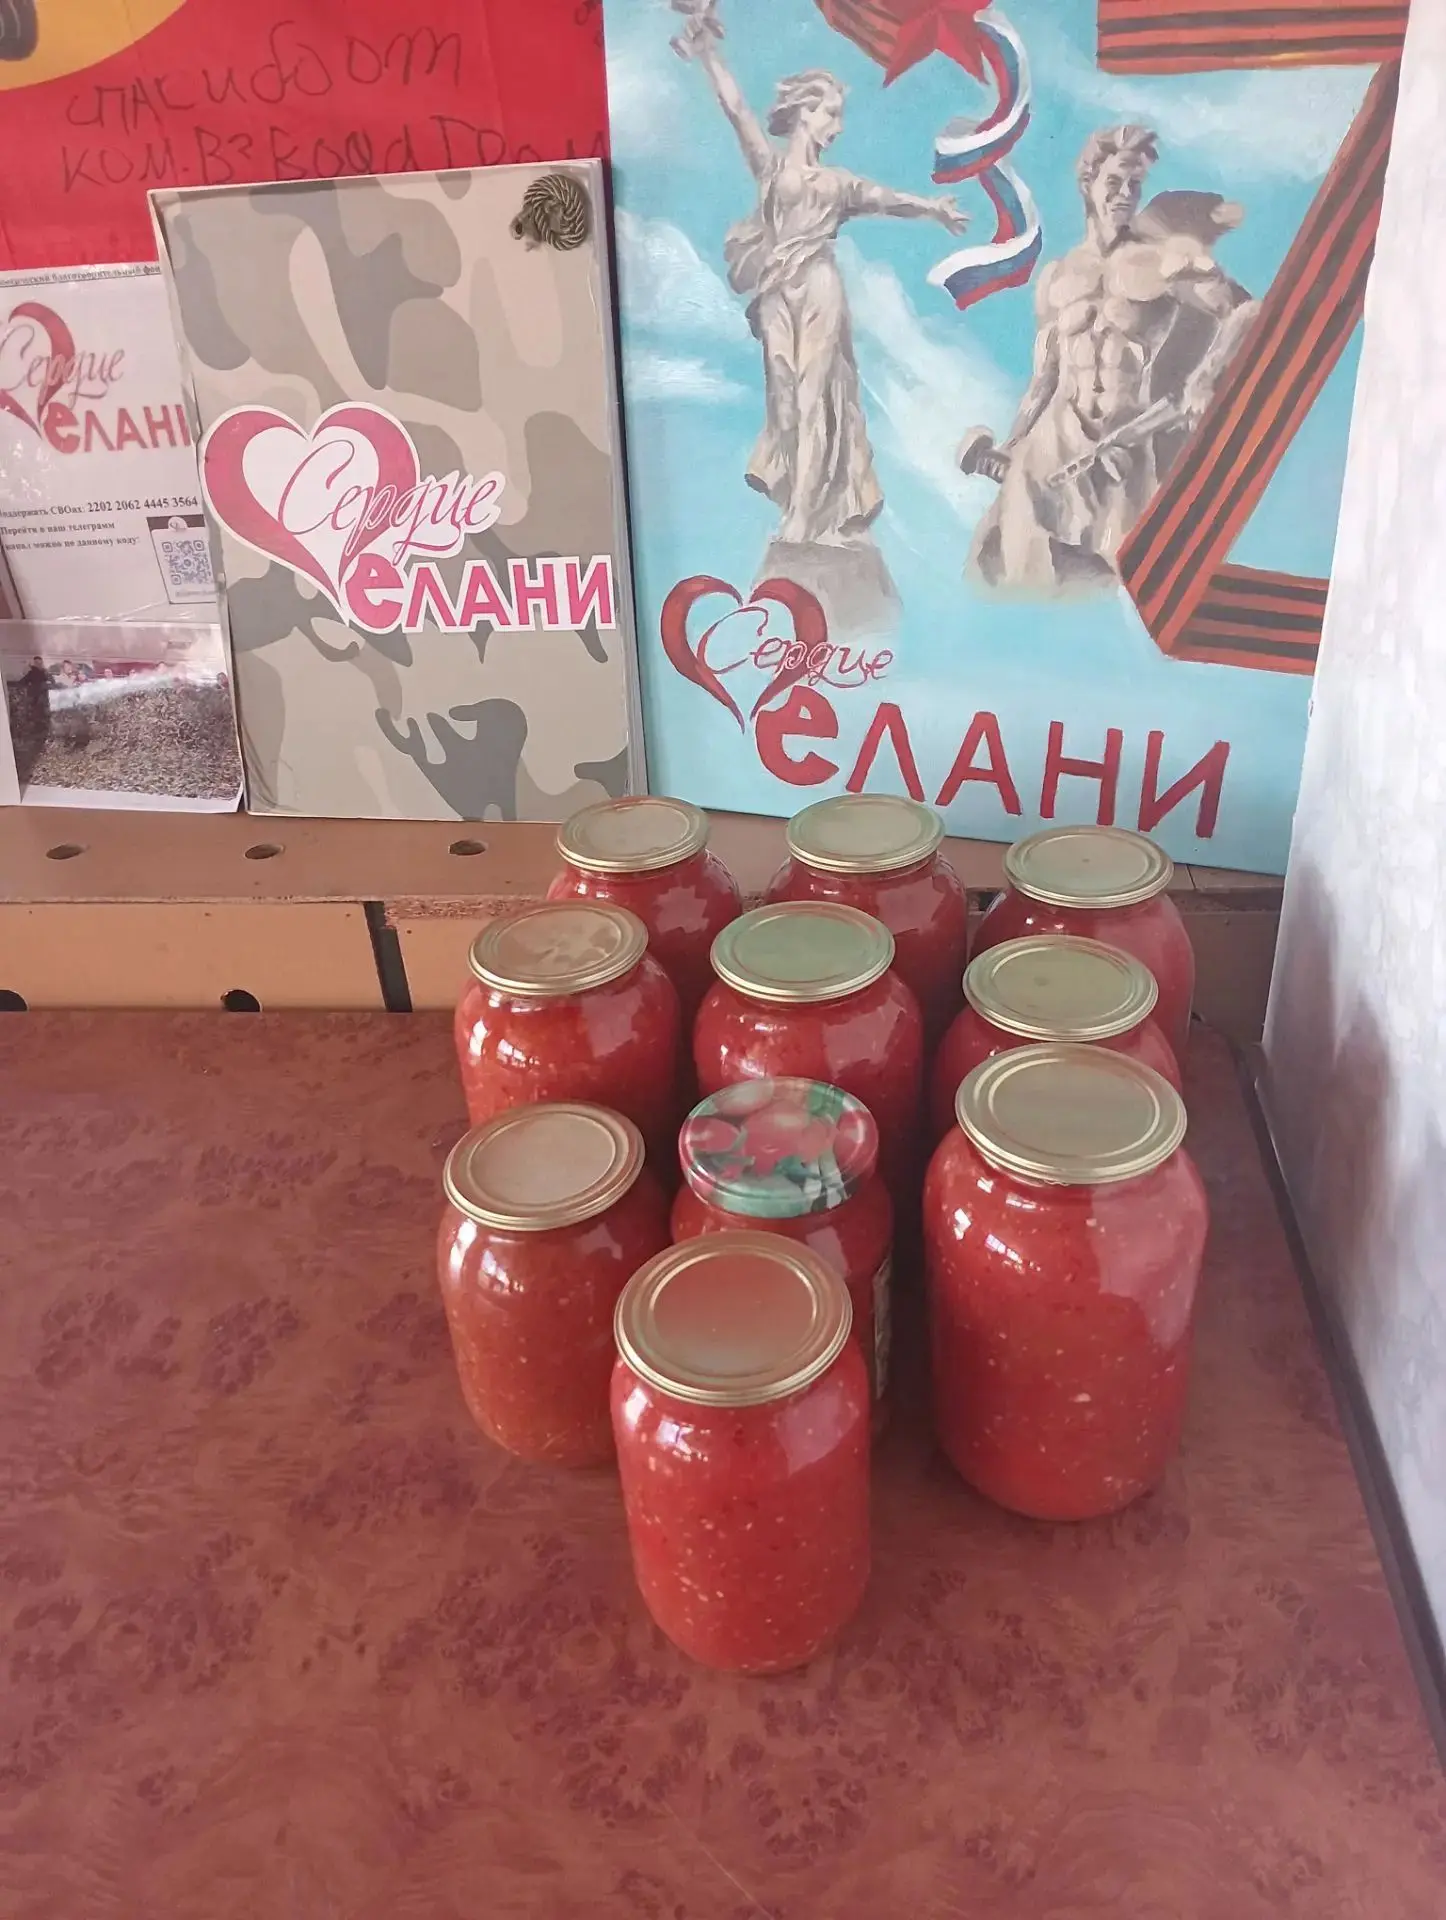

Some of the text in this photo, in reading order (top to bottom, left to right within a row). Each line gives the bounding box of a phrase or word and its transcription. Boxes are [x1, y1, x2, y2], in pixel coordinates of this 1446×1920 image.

[87, 501, 112, 512] 2202
[116, 499, 140, 511] 2062
[143, 498, 169, 509] 4445
[172, 496, 198, 507] 3564
[278, 440, 498, 563] Сердце
[697, 606, 895, 689] Сердце
